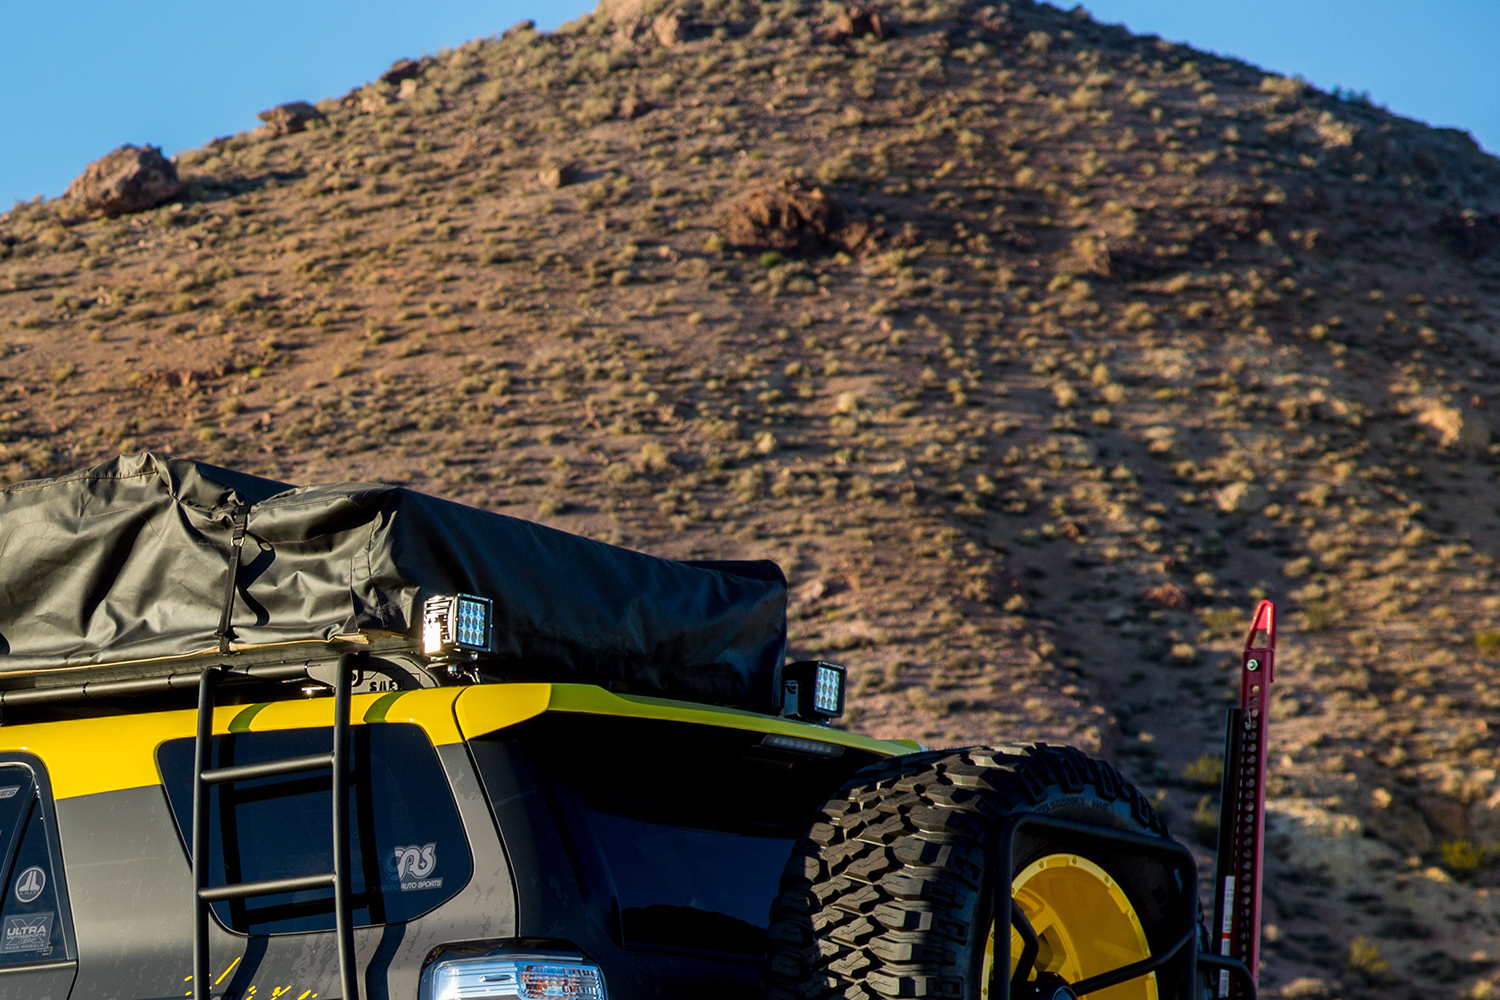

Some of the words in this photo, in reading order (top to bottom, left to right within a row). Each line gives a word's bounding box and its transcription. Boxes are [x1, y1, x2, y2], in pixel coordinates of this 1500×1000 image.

[401, 882, 417, 890] AUTO
[417, 879, 442, 888] SPORTS
[6, 925, 47, 936] ULTRA
